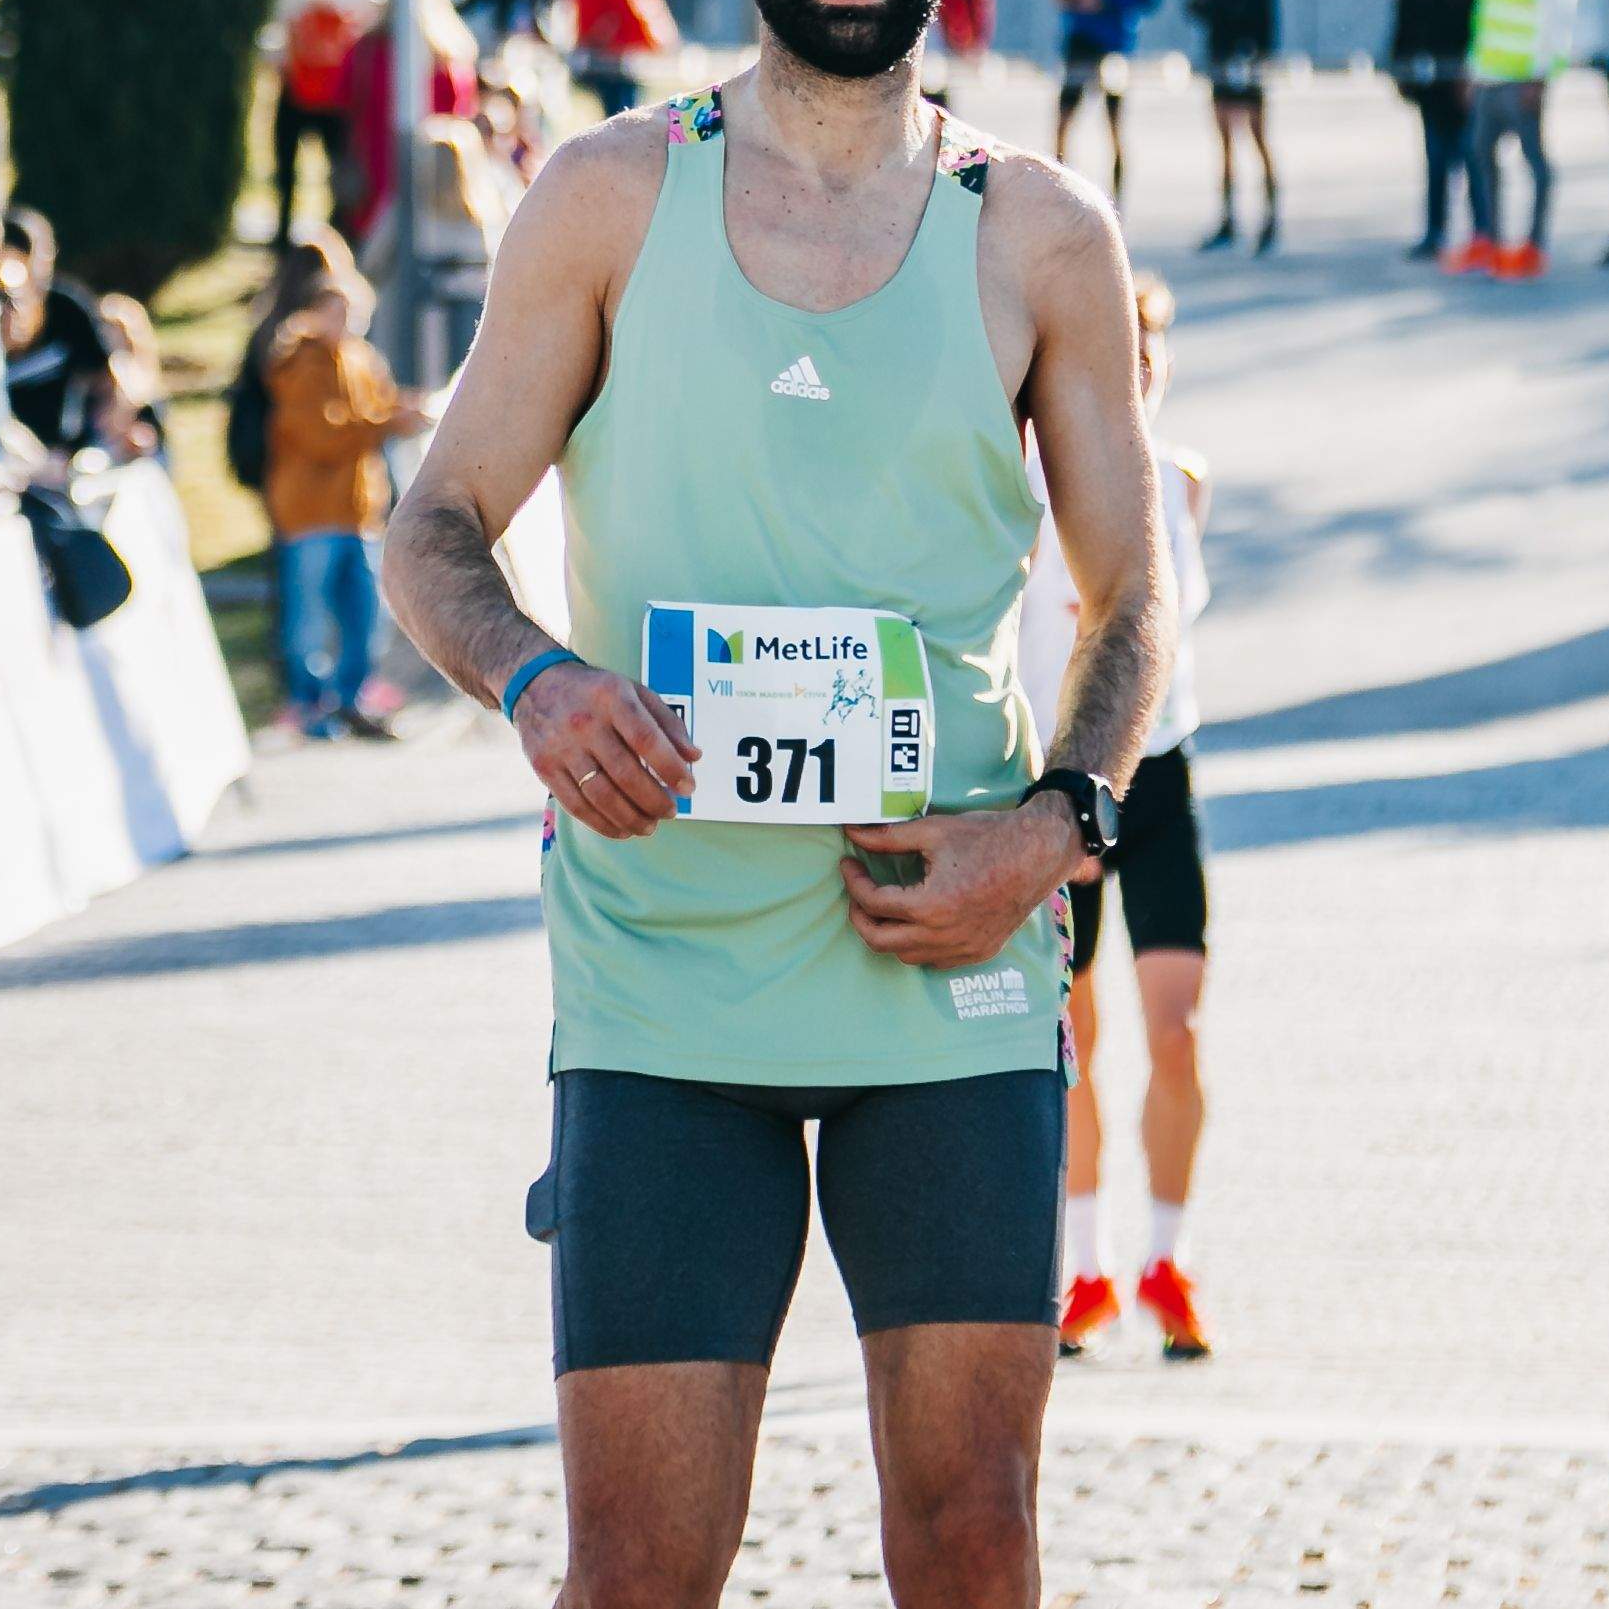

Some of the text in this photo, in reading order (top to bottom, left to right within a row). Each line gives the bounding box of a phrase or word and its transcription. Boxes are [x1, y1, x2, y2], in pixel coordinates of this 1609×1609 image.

[770, 380, 831, 401] adidas
[755, 636, 868, 661] MetLife
[736, 736, 835, 804] 371
[949, 973, 1000, 996] BMW
[952, 991, 1005, 1008] BERLIN
[956, 1002, 1029, 1021] MARATHON
